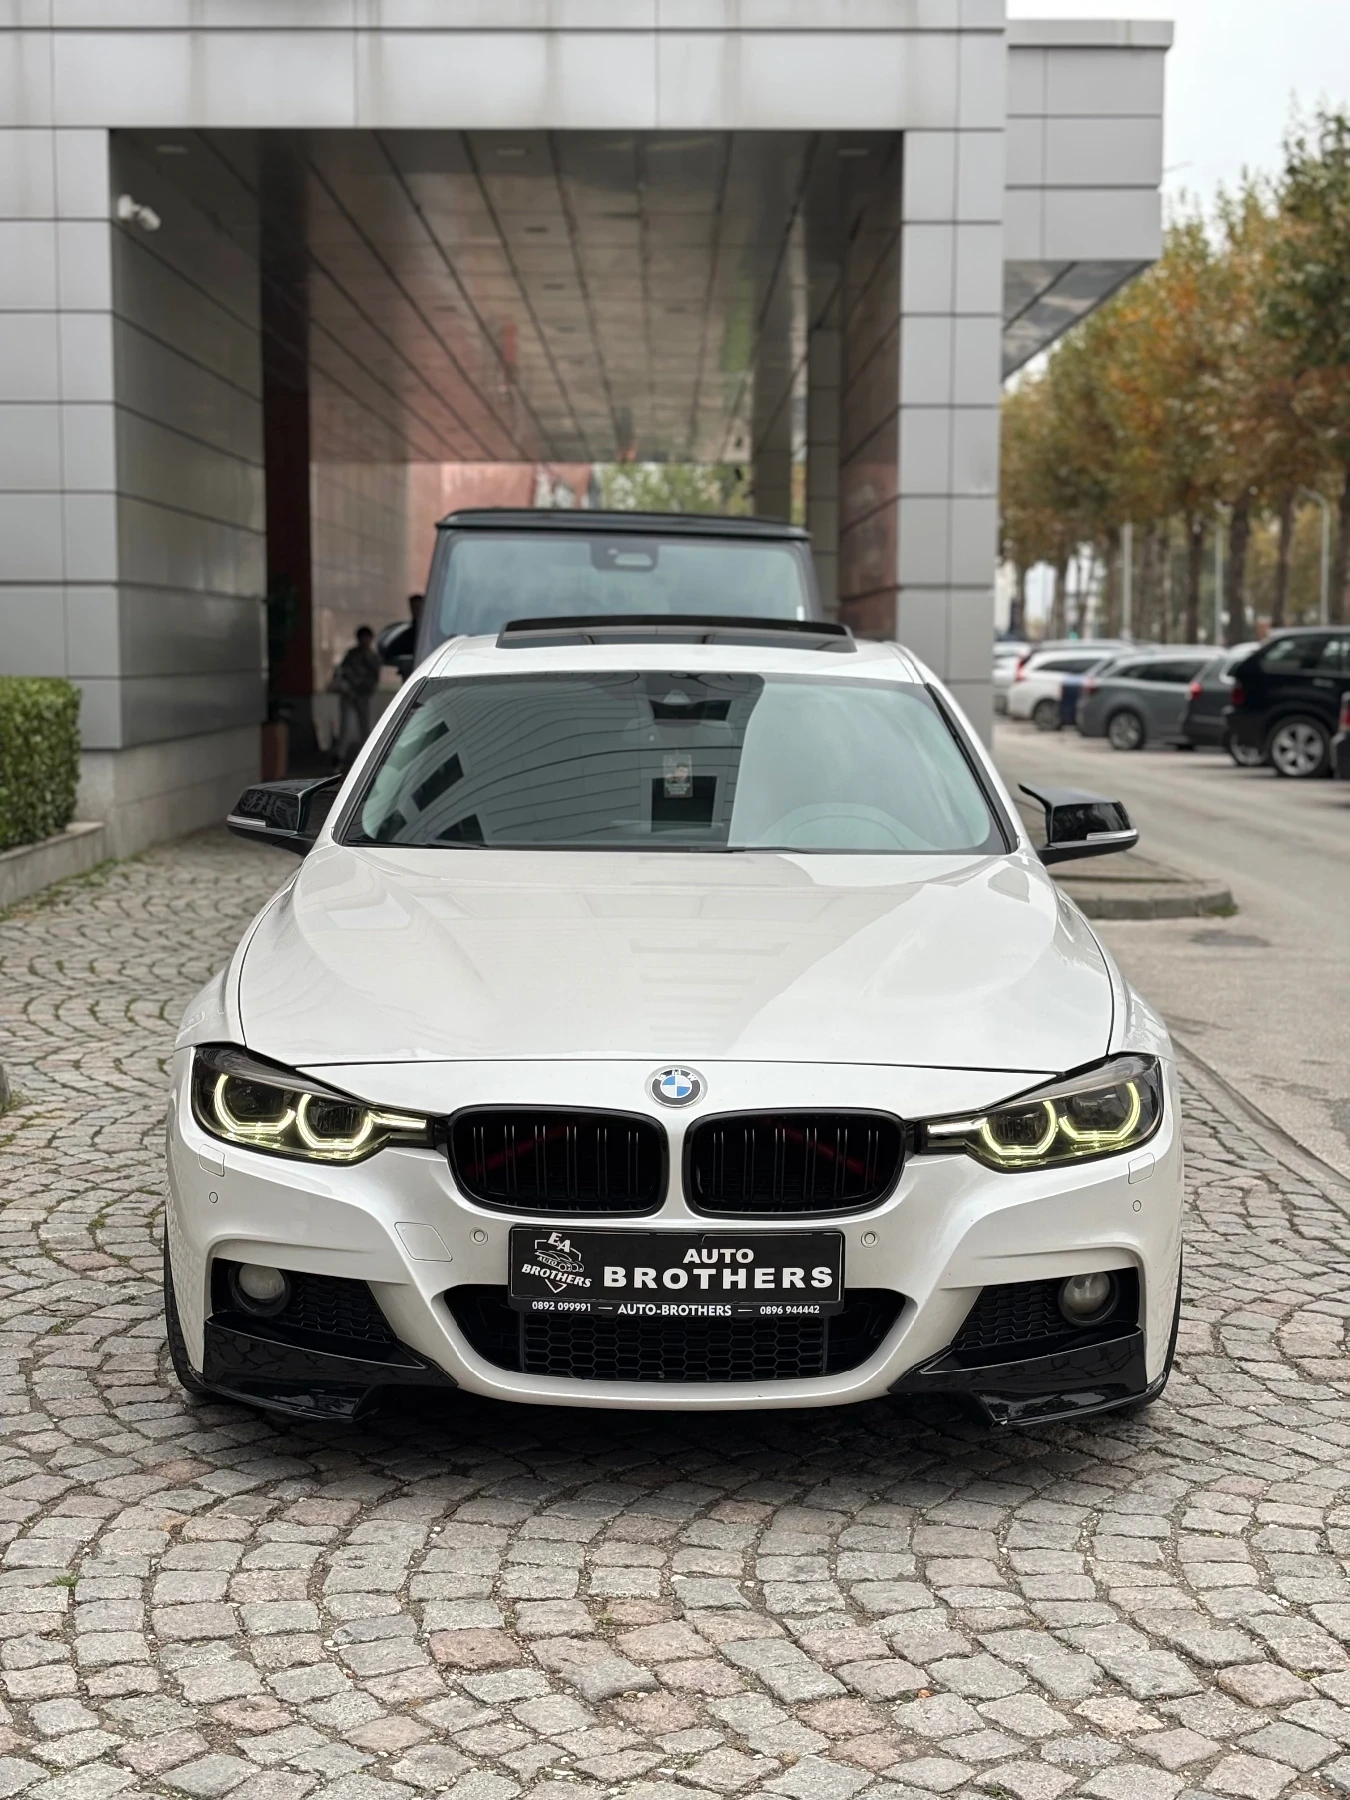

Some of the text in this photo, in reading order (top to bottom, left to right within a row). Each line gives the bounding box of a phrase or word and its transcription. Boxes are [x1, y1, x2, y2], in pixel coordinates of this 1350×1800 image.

[655, 1069, 698, 1081] BMW
[536, 1256, 558, 1267] AUTO
[682, 1248, 755, 1264] AUTO
[521, 1263, 593, 1288] BROTHERS
[603, 1266, 834, 1290] BROTHERS
[531, 1301, 820, 1317] 0892 099991 AUTO-BROTHERS 0896 944442
